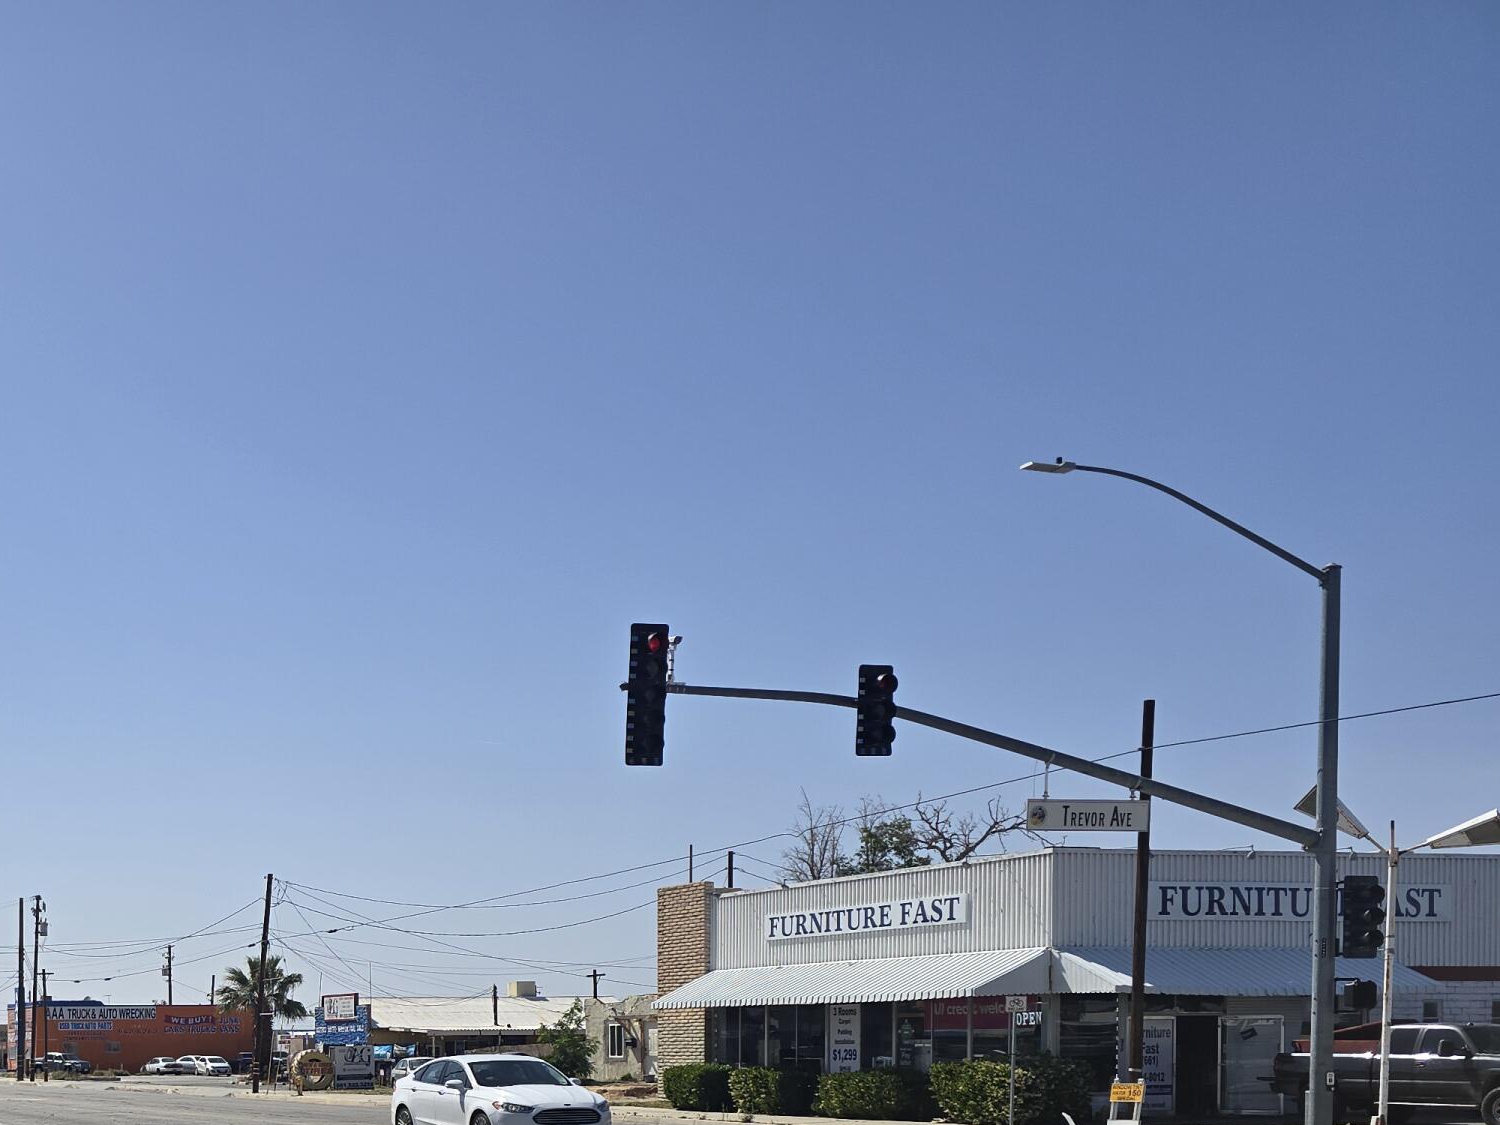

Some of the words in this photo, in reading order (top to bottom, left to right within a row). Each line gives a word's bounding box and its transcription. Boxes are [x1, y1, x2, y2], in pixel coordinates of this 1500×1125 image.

[1157, 885, 1345, 918] FURNITU
[768, 904, 893, 938] FURNITURE
[899, 896, 960, 926] FAST
[46, 1007, 65, 1019] AAA
[99, 1007, 118, 1019] AUTO
[119, 1007, 156, 1019] WRECKING
[833, 1007, 837, 1016] 3
[839, 1006, 857, 1016] Rooms
[171, 1016, 185, 1025] WE
[1016, 1011, 1043, 1026] OPEN
[832, 1048, 858, 1062] $1,299
